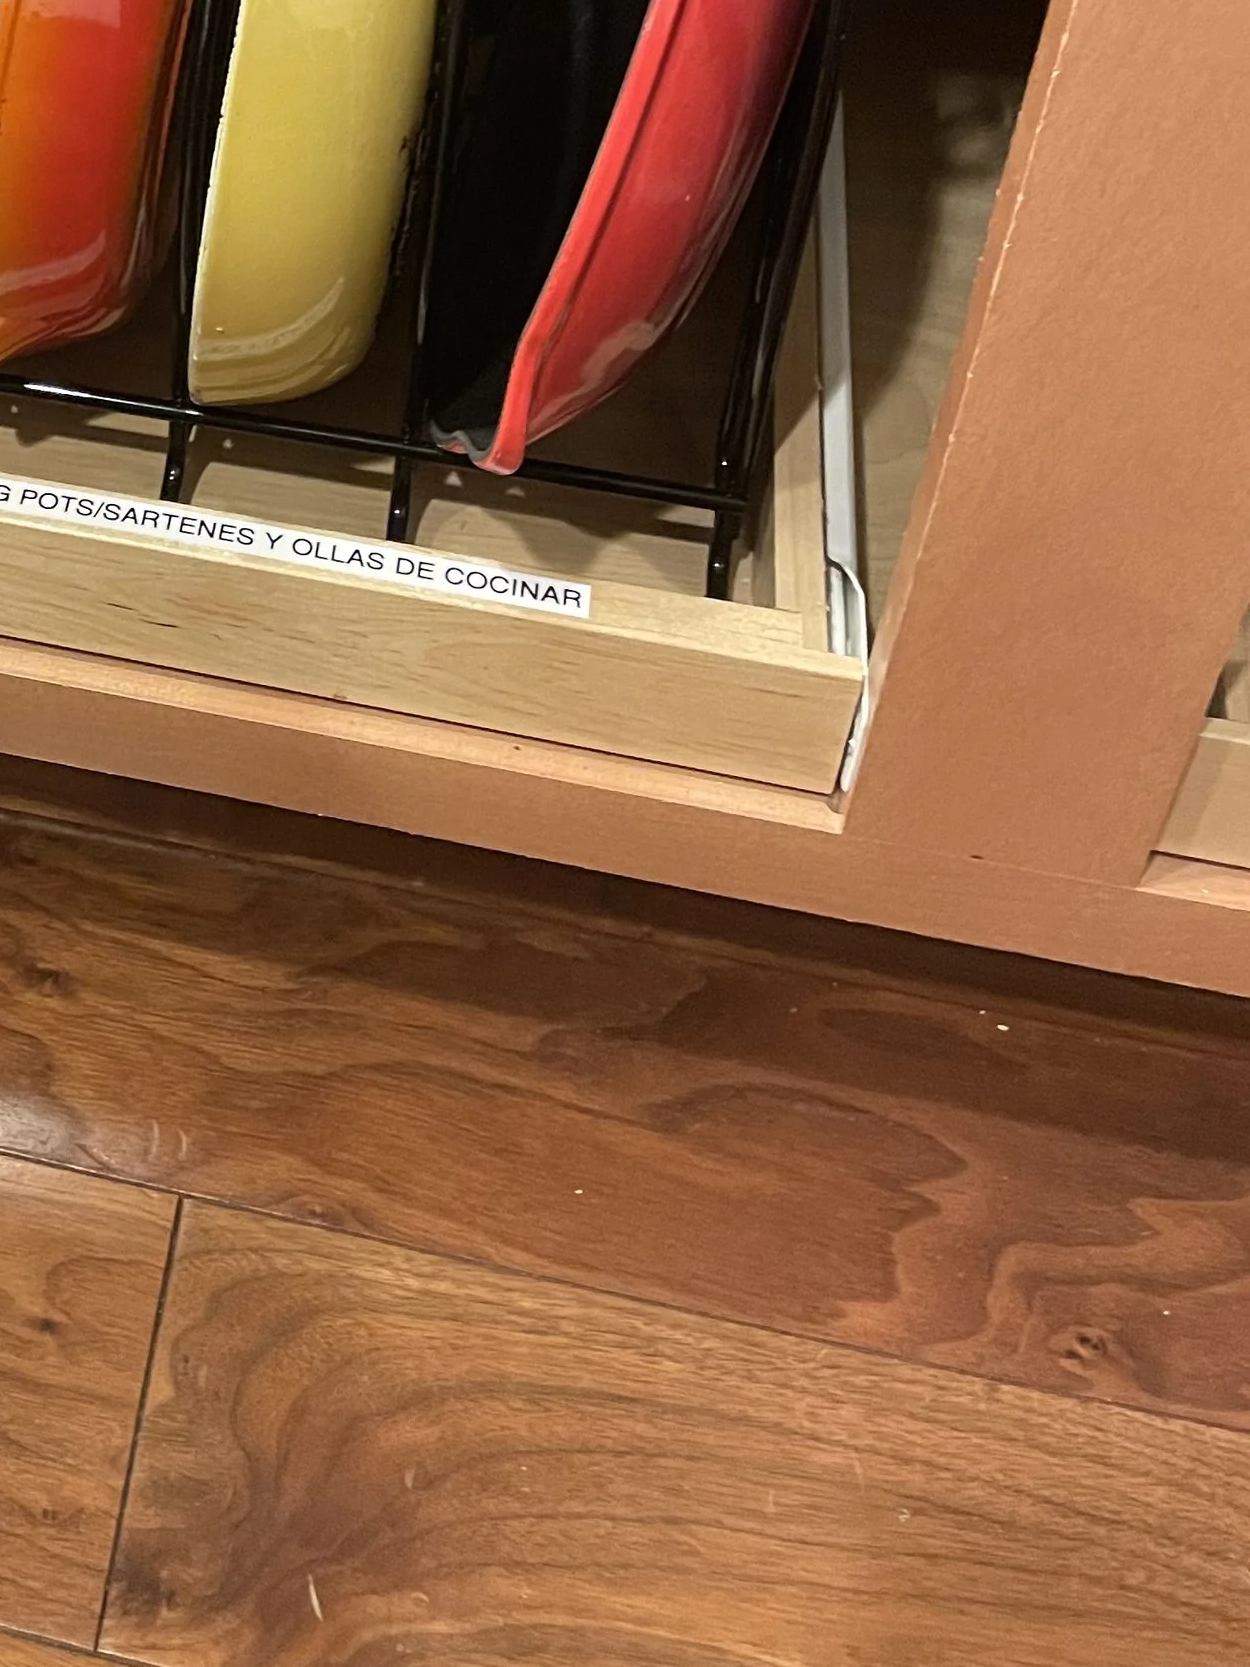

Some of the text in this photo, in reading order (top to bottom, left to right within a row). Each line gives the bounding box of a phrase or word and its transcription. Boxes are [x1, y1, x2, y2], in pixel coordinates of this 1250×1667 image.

[19, 489, 255, 546] POTS/SARTENES
[266, 532, 283, 550] Y
[292, 538, 384, 570] OLLAS
[396, 557, 435, 580] DE
[445, 567, 581, 608] COCINAR
